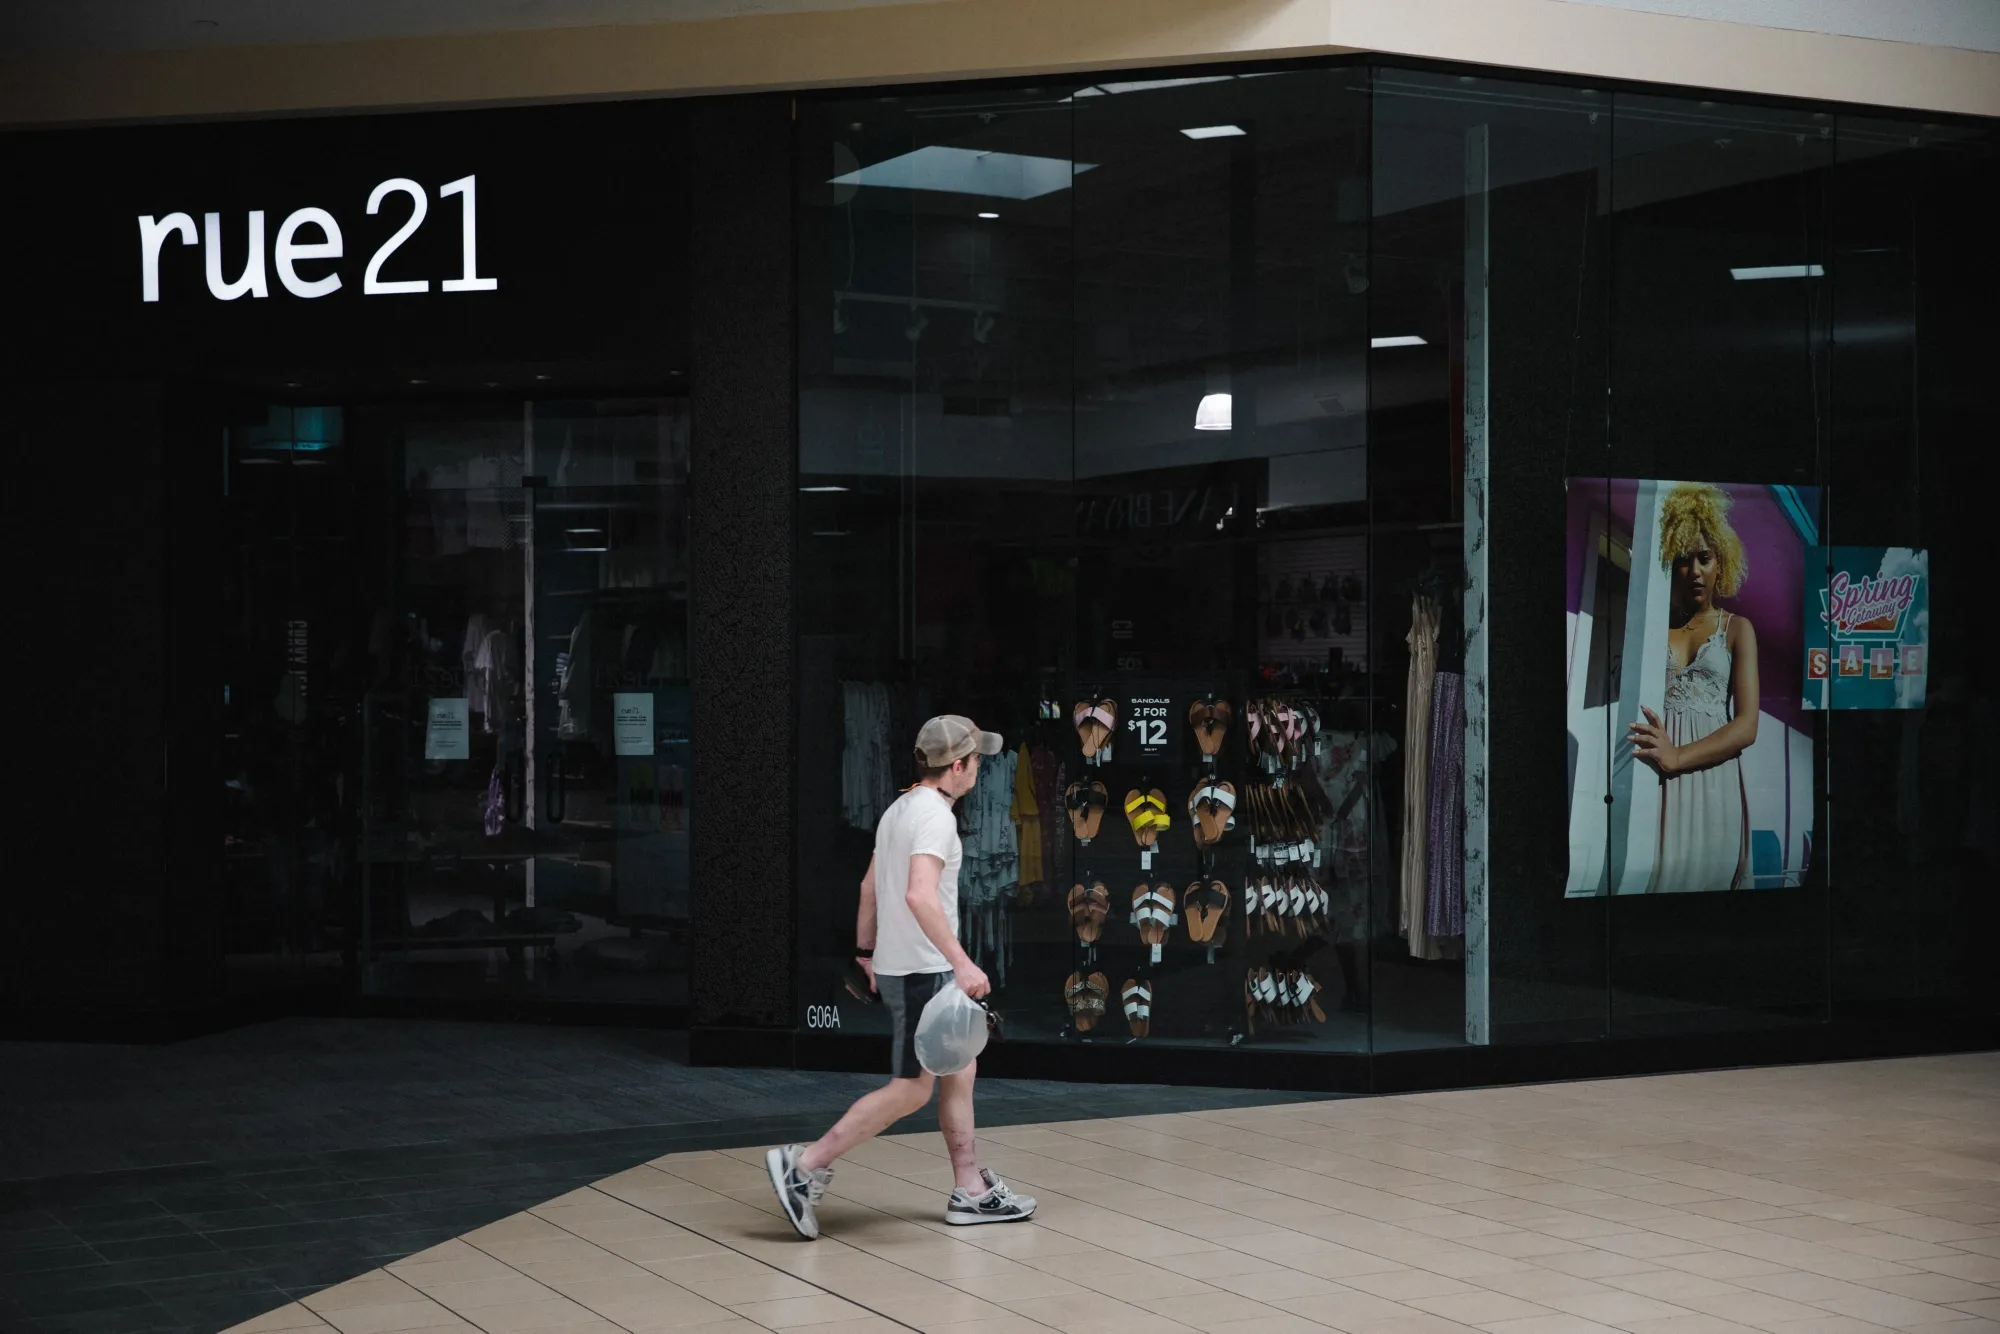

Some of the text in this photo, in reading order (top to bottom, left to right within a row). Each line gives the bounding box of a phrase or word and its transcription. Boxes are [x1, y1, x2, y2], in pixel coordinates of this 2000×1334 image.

[1821, 571, 1914, 622] Spring
[1846, 602, 1896, 634] Getaway
[1813, 650, 1918, 675] SALE
[1133, 707, 1167, 717] 2 FOR
[1127, 719, 1168, 745] $12
[807, 1005, 841, 1028] G06A
